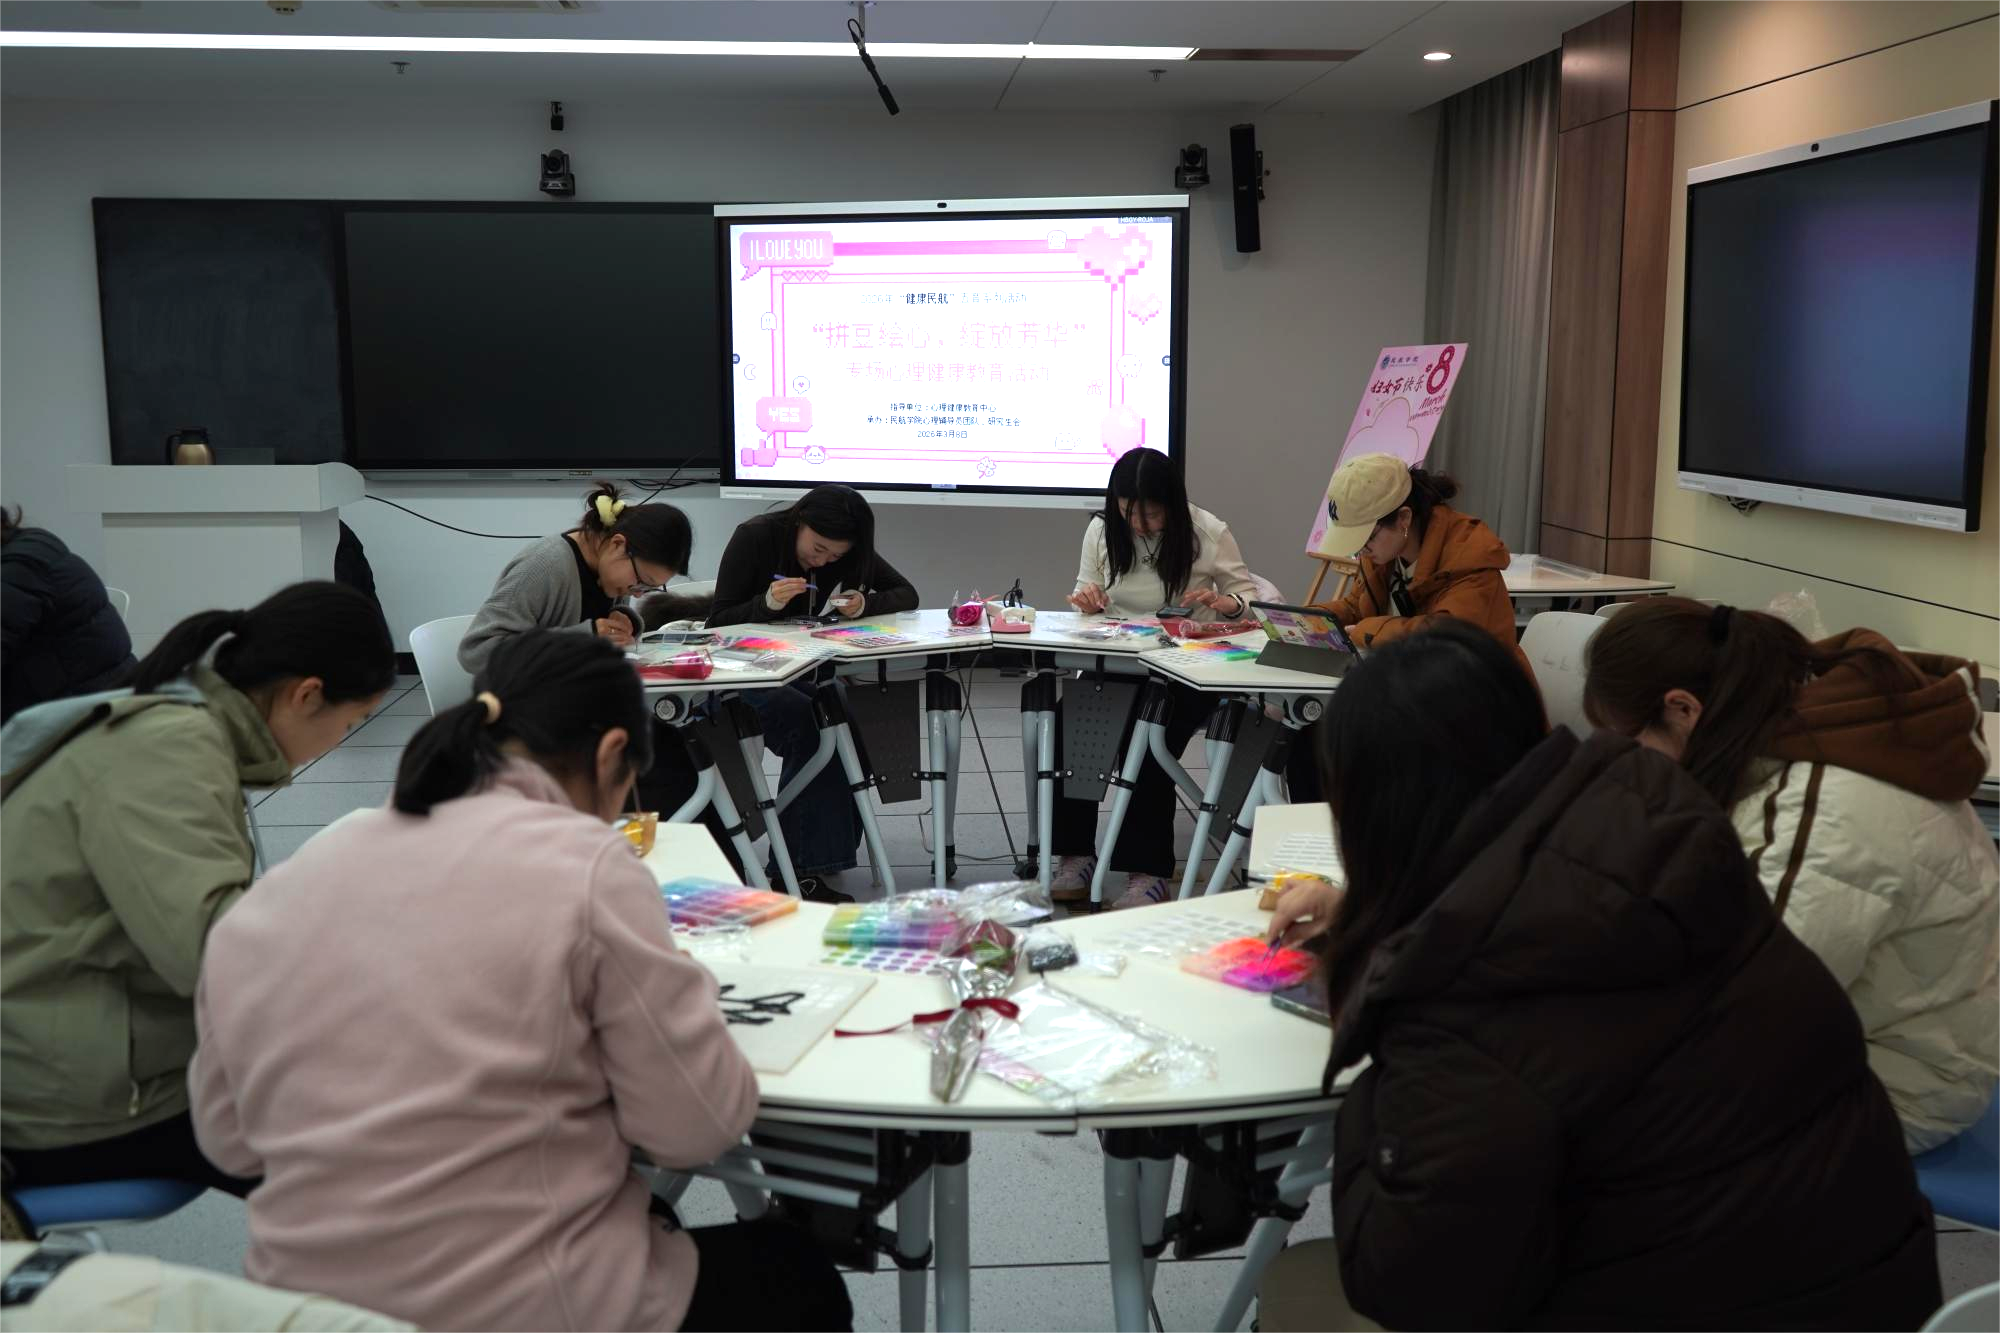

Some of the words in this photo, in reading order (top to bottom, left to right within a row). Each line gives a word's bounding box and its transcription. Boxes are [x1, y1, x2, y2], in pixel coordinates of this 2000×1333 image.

[794, 238, 823, 259] YOU
[846, 361, 1050, 383] 专场心理健康教育活动
[1427, 345, 1456, 395] 8
[768, 407, 800, 423] YES
[917, 429, 968, 439] 2026年3月8日
